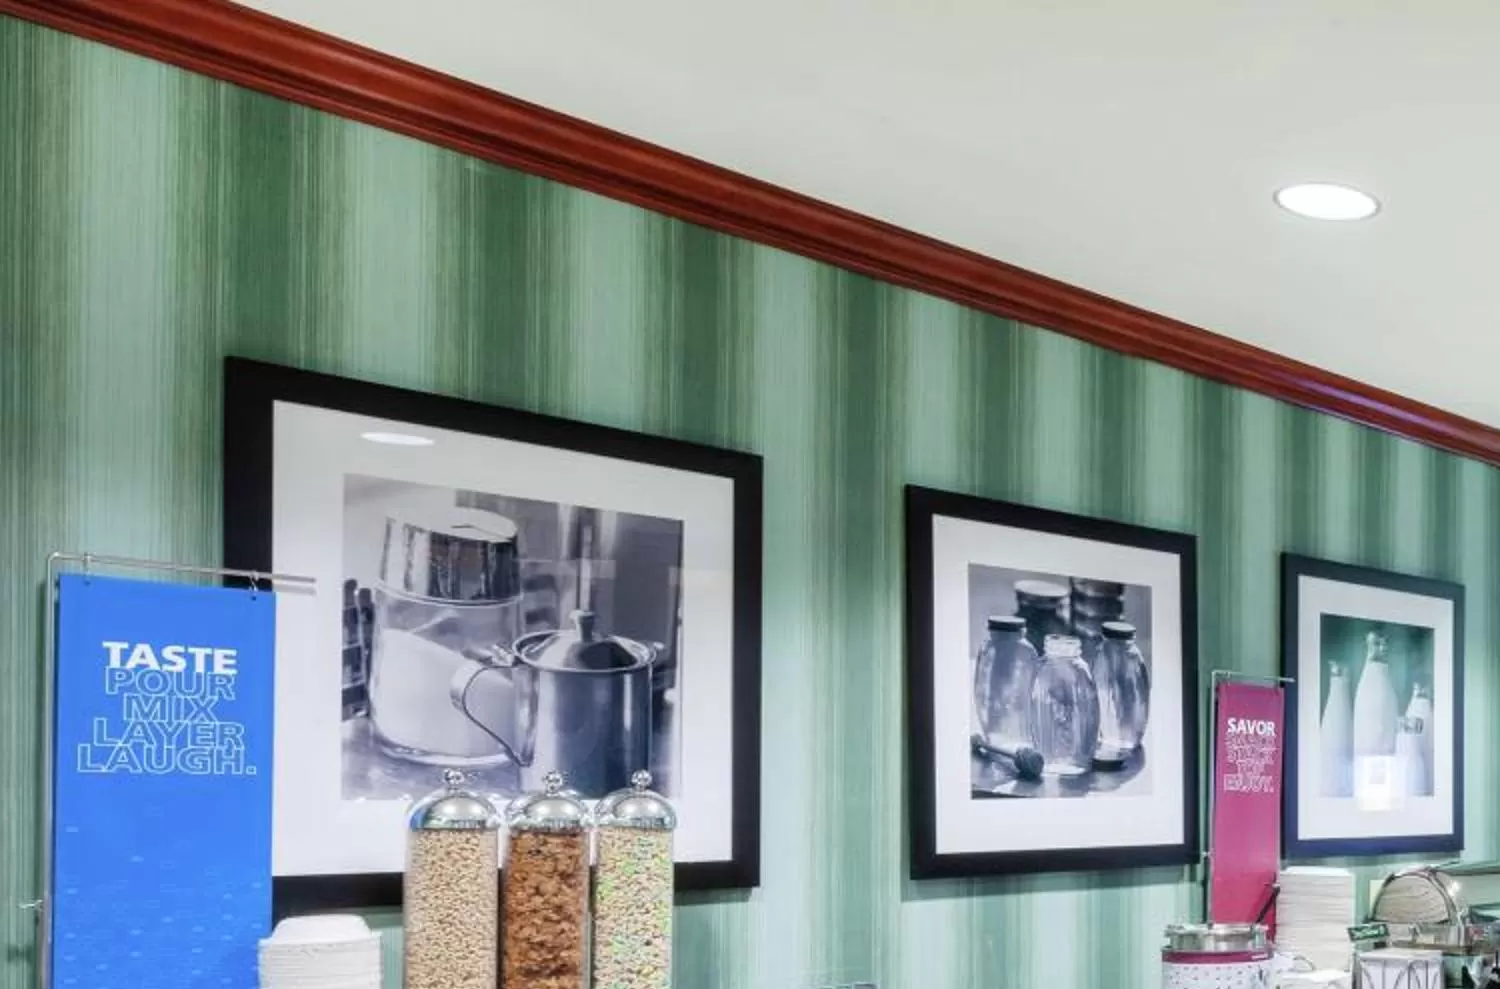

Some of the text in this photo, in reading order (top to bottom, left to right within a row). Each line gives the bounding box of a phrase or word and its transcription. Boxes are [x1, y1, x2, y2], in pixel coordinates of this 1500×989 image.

[102, 641, 238, 675] TASTE
[105, 666, 236, 701] POUR
[123, 693, 219, 724] MIX
[93, 717, 245, 750] LAYER
[1227, 717, 1276, 737] SAVOR
[77, 743, 257, 775] LAUGH.
